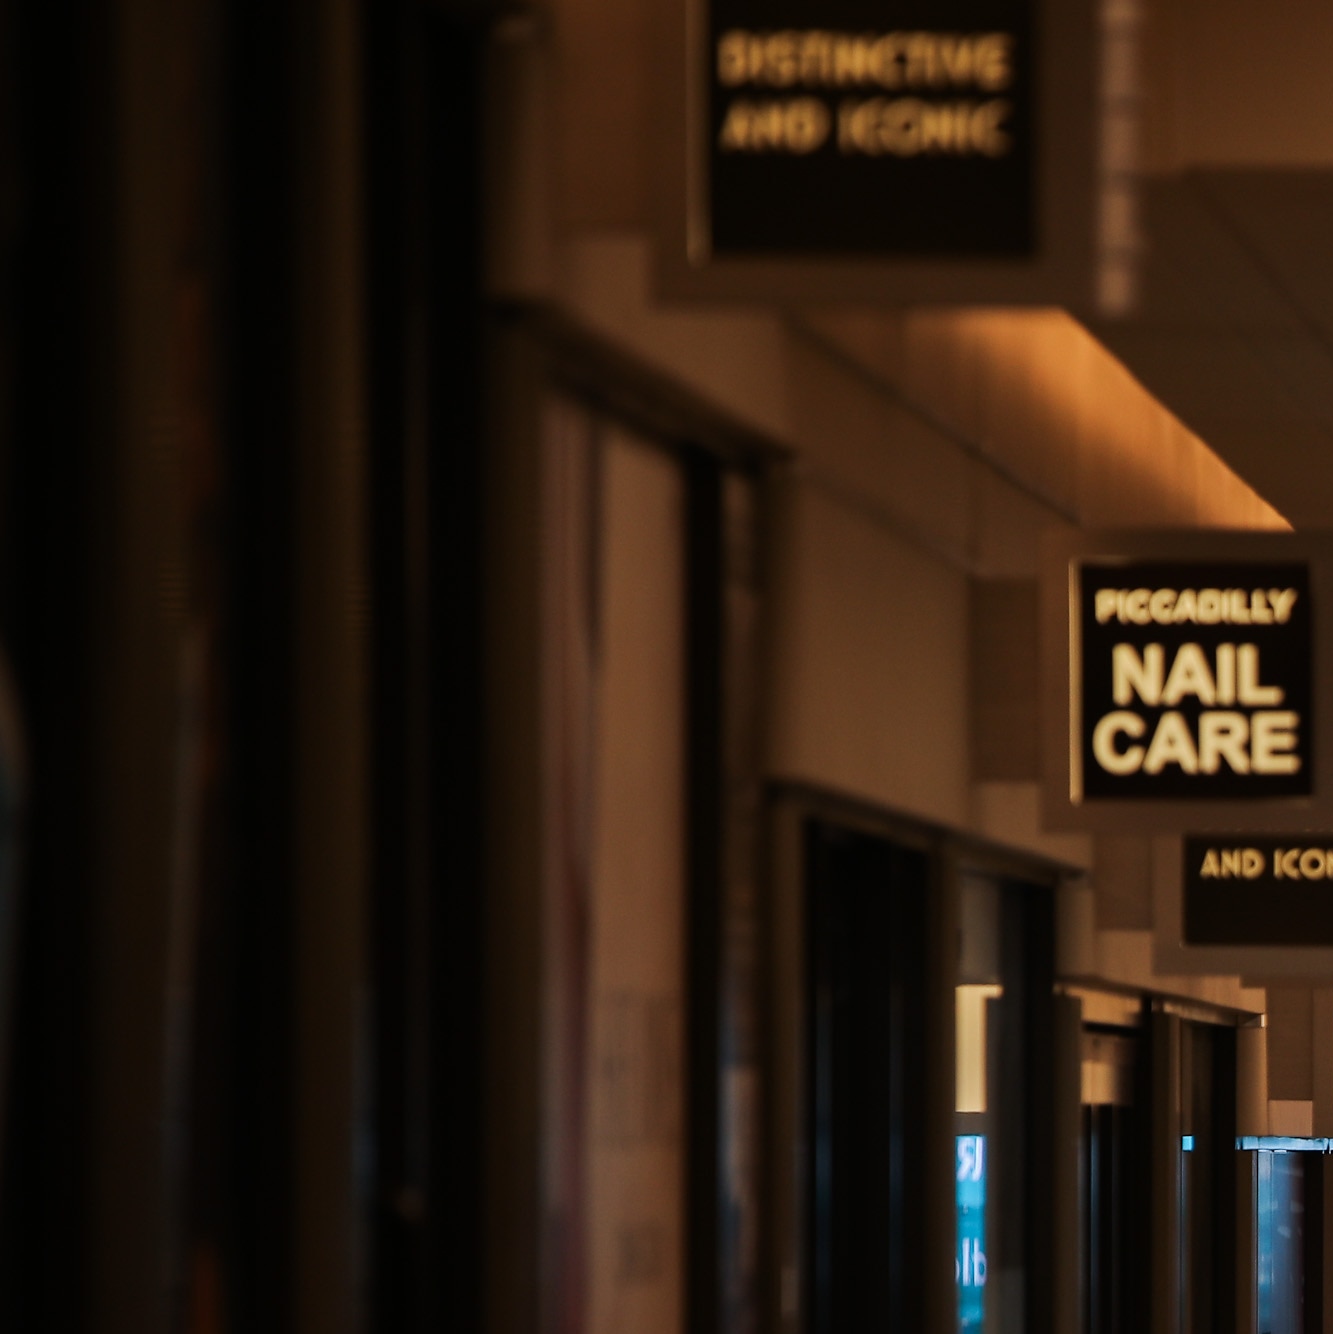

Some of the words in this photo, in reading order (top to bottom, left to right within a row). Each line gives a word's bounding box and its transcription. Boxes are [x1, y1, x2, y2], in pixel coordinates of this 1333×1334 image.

[717, 28, 1012, 90] DISTINCTIVE
[719, 98, 832, 155] AND
[837, 98, 1012, 157] ICONIC
[1094, 588, 1297, 625] PICCADILLY
[1111, 643, 1284, 707] NAIL
[1092, 711, 1301, 776] CARE
[1201, 848, 1265, 880] AND
